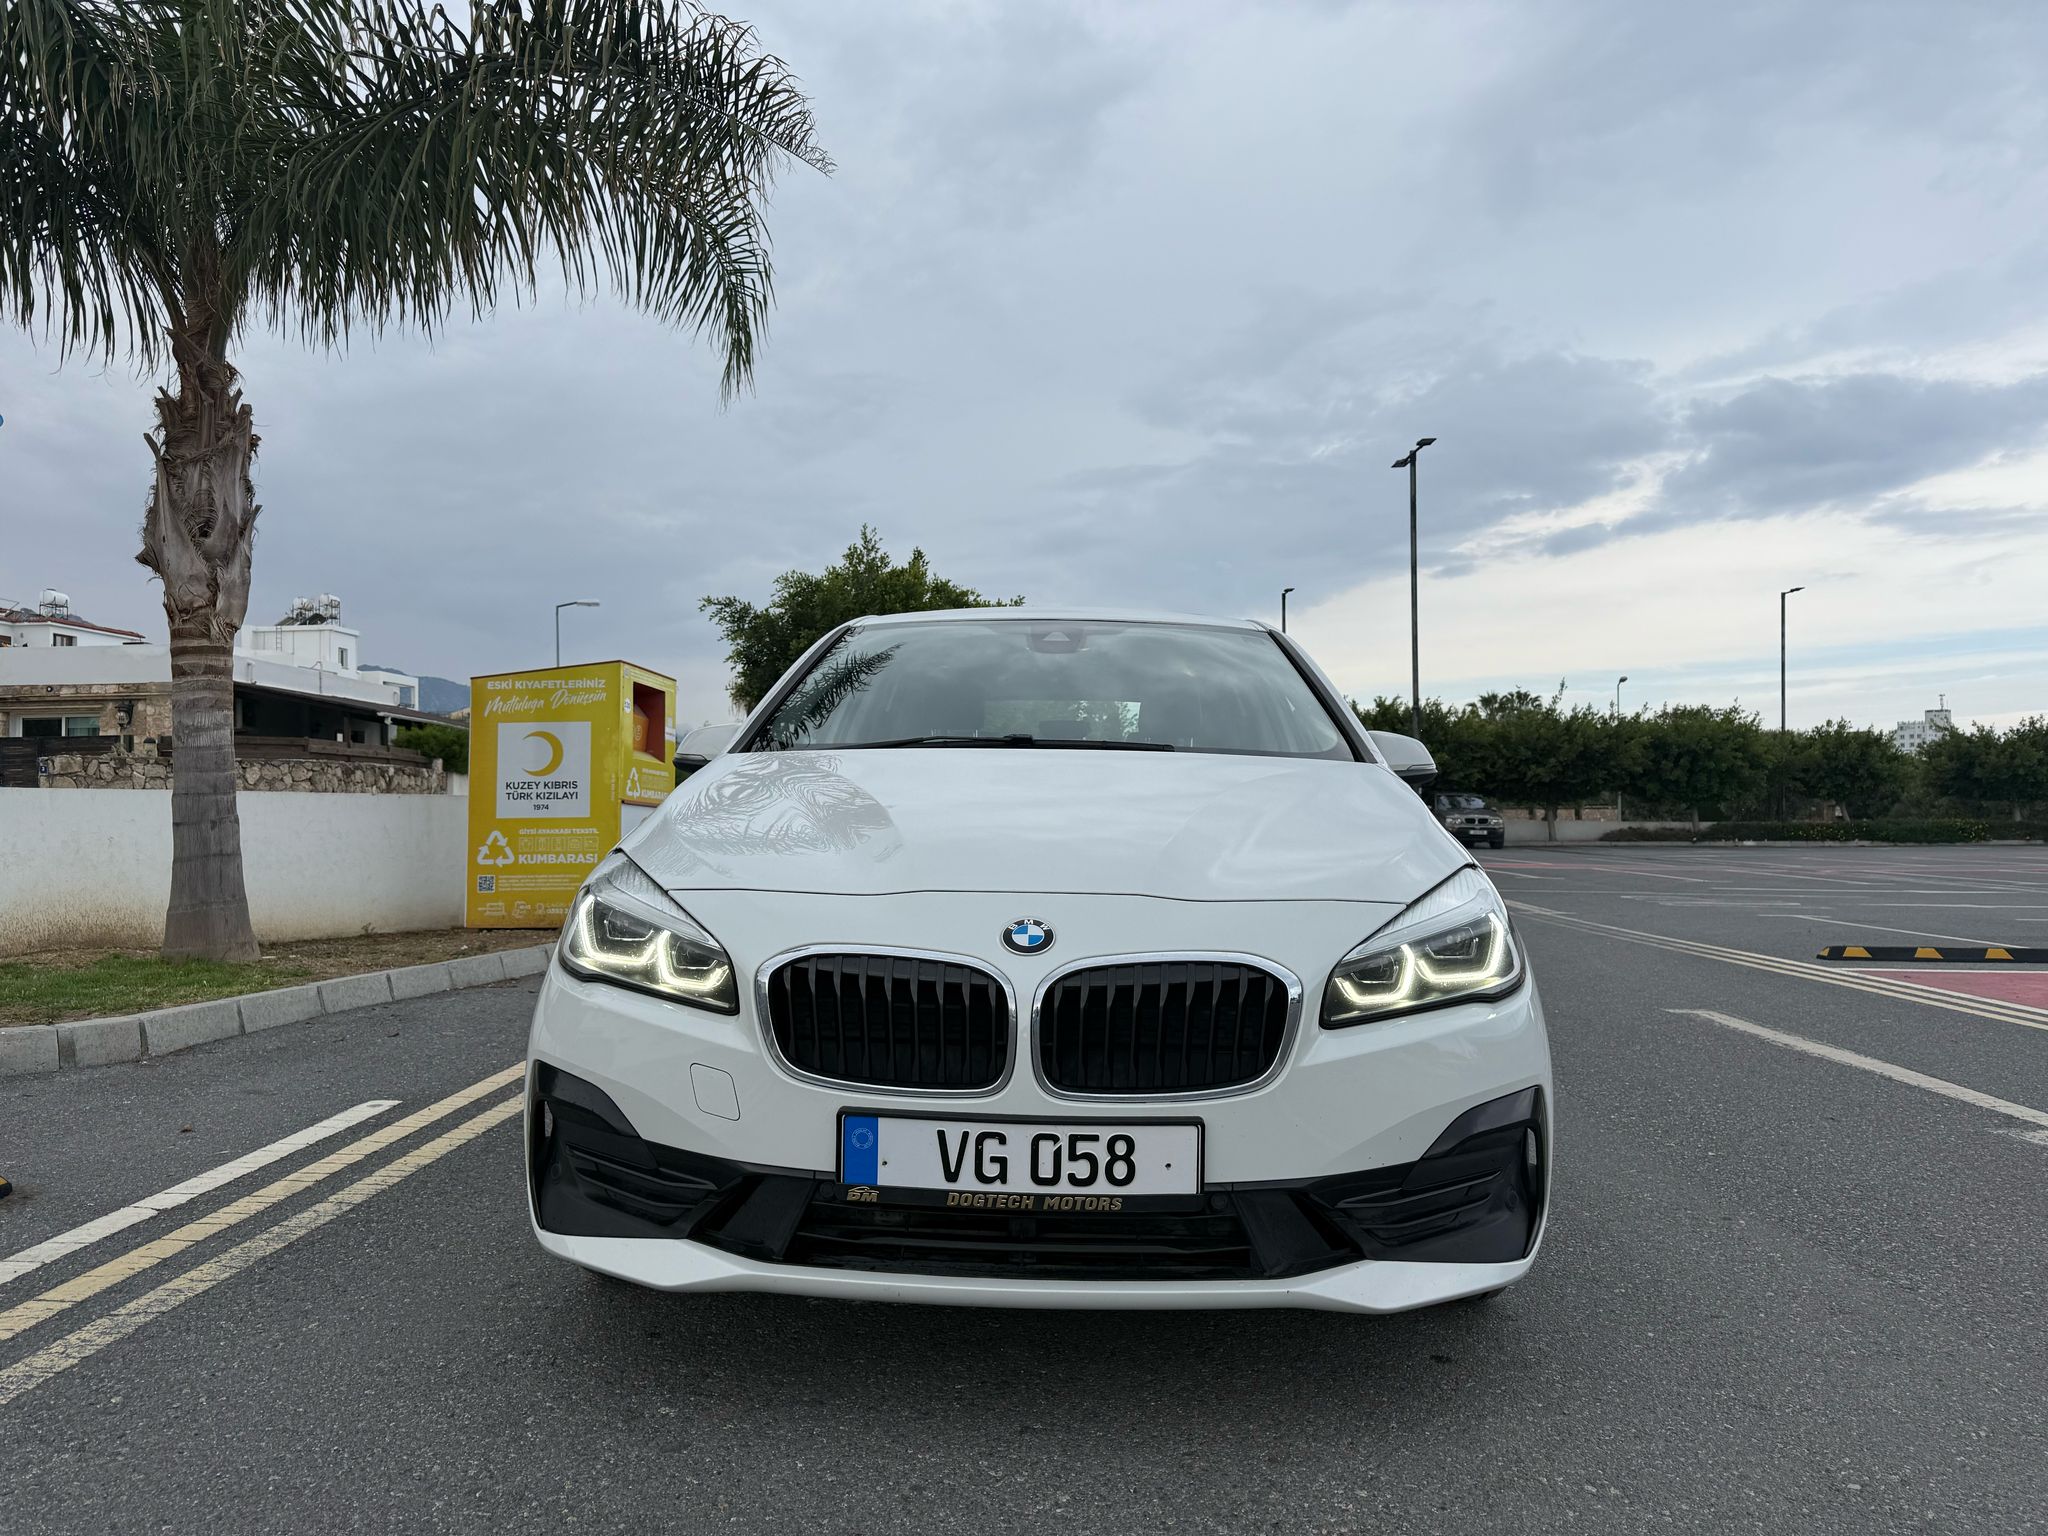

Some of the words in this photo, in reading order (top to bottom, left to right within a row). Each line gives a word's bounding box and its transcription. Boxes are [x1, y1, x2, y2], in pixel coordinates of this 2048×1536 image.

[487, 679, 512, 690] ESKİ
[515, 678, 606, 689] KIYAFETLERİNİZ
[505, 781, 541, 790] KUZEY
[543, 780, 578, 790] KIBRIS
[506, 791, 533, 800] TÜRK
[535, 791, 578, 800] KIZILAYI
[518, 854, 598, 864] KUMBARASI
[1008, 919, 1051, 930] BMW
[936, 1129, 1009, 1184] VG
[1030, 1132, 1136, 1186] 058
[946, 1192, 1035, 1209] DOGTECH
[1043, 1196, 1123, 1211] MOTORS
